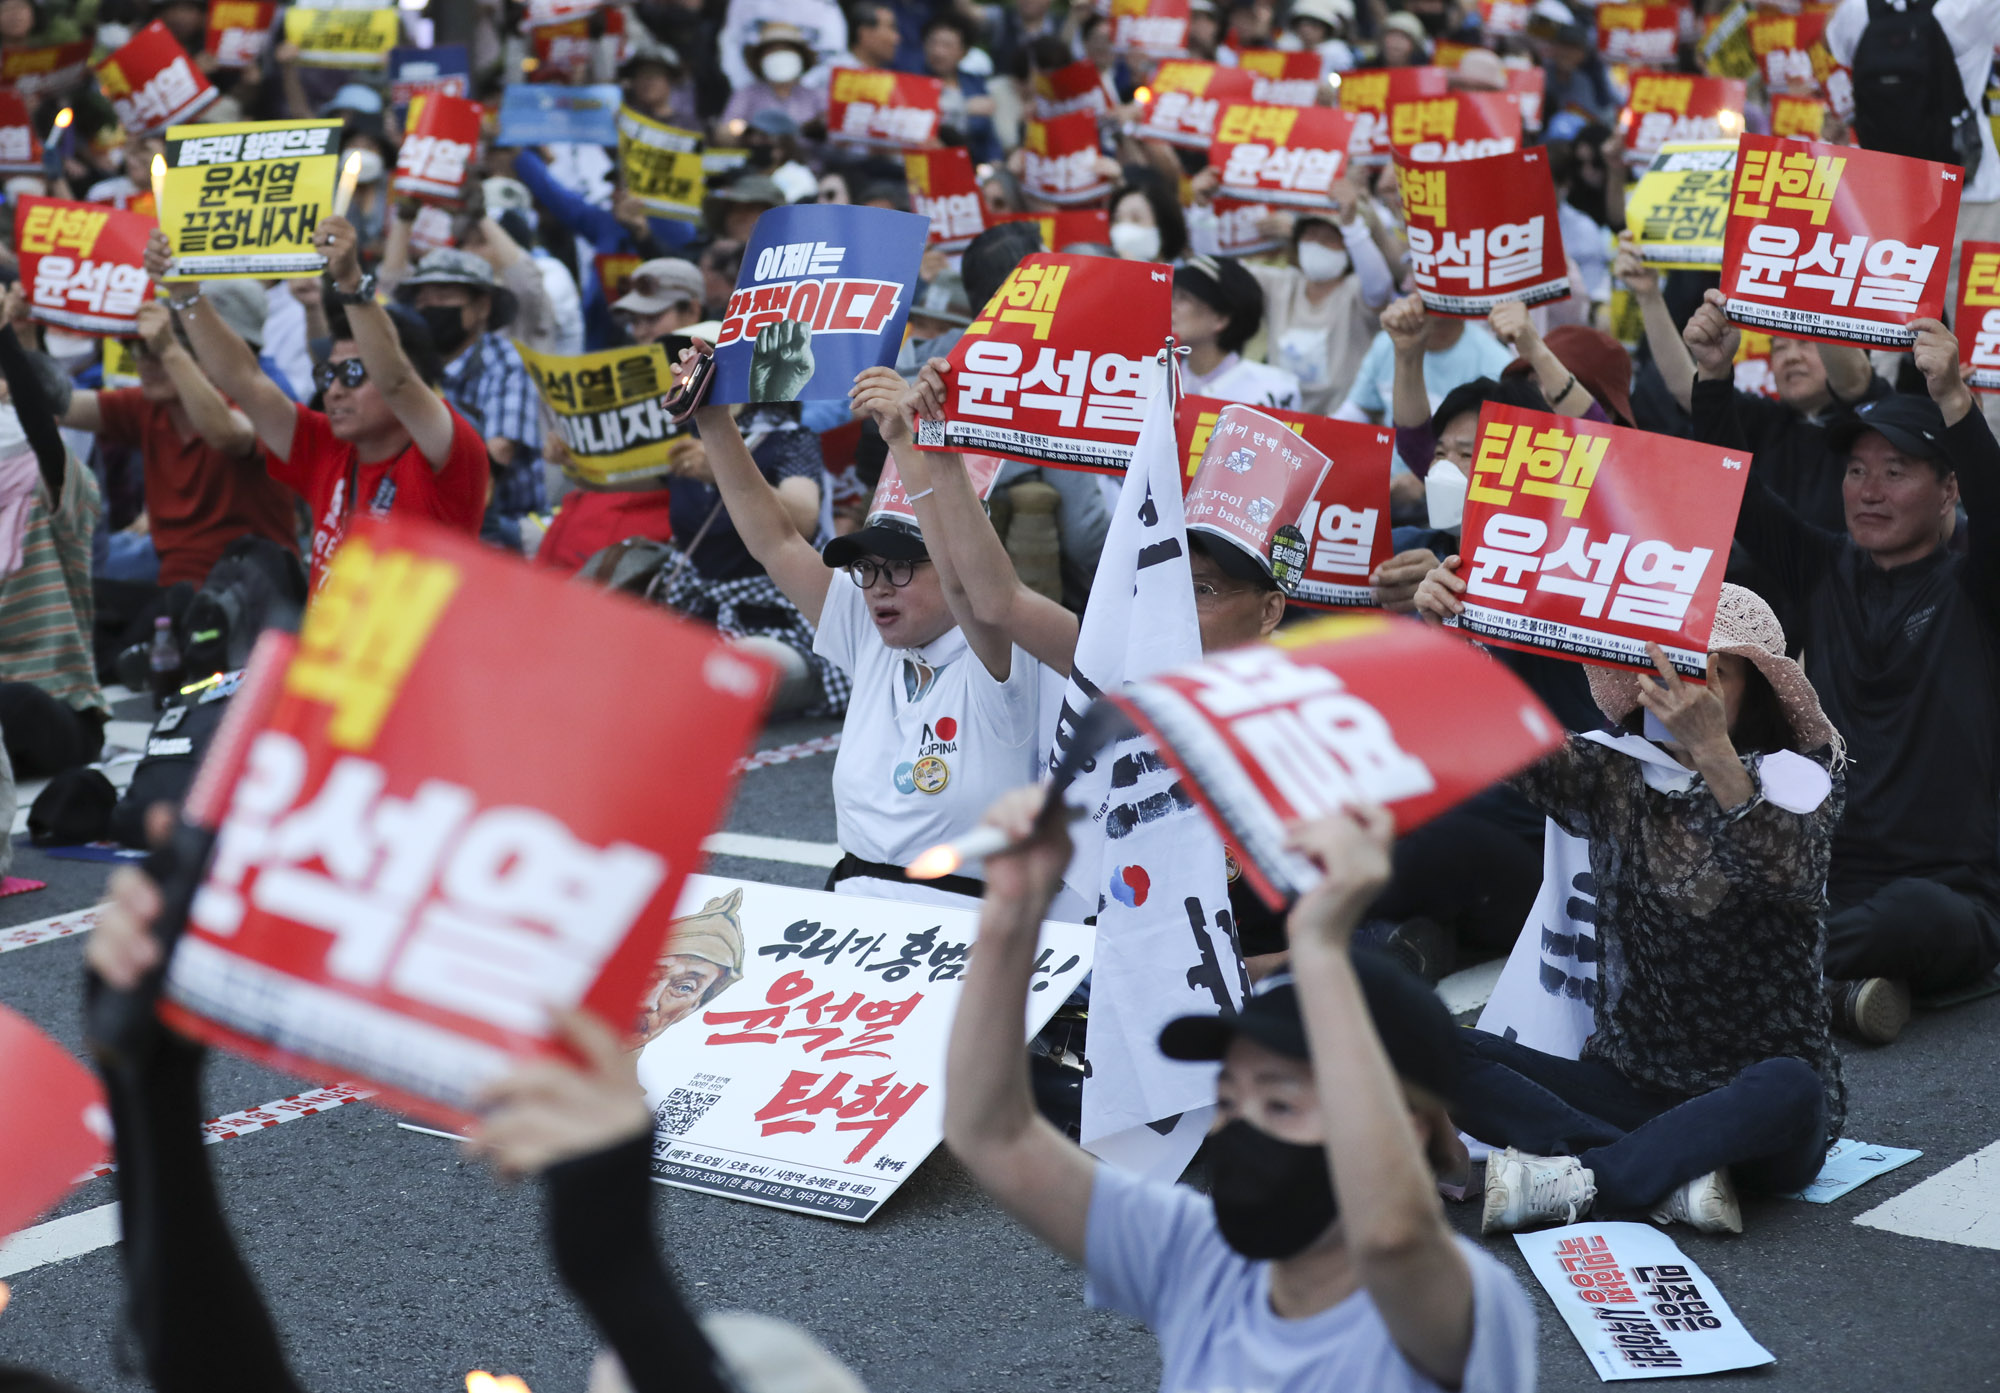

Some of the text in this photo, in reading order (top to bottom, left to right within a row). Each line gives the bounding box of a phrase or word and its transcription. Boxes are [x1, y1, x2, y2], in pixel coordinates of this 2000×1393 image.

[200, 162, 300, 207] 윤석열
[1733, 150, 1847, 225] 탄핵
[21, 205, 108, 257] 탄핵
[33, 254, 152, 315] 윤석열
[754, 241, 846, 282] 이제는
[1736, 225, 1939, 313] 윤석열
[1782, 310, 1821, 324] 촛불대행진
[957, 340, 1157, 432] 윤석열
[1013, 432, 1048, 447] 촛불대행진
[1223, 422, 1302, 471] 새끼 탄핵 하라
[1468, 422, 1611, 519] 탄핵
[1192, 502, 1269, 546] the bastard.
[1466, 513, 1714, 631] 윤석열
[1487, 626, 1532, 642] 100-036-164860
[1561, 642, 1575, 651] ARS
[1575, 645, 1617, 660] 060-707-3300
[1520, 618, 1567, 638] 촛불대행진
[758, 918, 888, 967] 우리가
[702, 970, 925, 1062] 윤석열
[754, 1069, 929, 1165] 탄핵
[660, 1164, 727, 1184] 060-707-3300
[724, 1176, 740, 1188] (한
[740, 1179, 764, 1192] 통에
[762, 1184, 780, 1196] 1만
[780, 1187, 793, 1199] 원,
[795, 1190, 818, 1203] 여러
[816, 1195, 831, 1205] 번
[829, 1197, 856, 1211] 가능)
[666, 1148, 693, 1160] (매주
[691, 1153, 723, 1168] 토요일
[720, 1160, 730, 1169] /
[727, 1160, 750, 1172] 오후
[749, 1165, 769, 1176] 6시
[765, 1168, 776, 1178] /
[774, 1170, 838, 1190] 시청역-숭례문
[836, 1181, 851, 1191] 앞
[850, 1183, 877, 1198] 대로)
[1556, 1235, 1683, 1368] 국민항쟁 시작하라!
[1633, 1264, 1723, 1332] 민주당은
